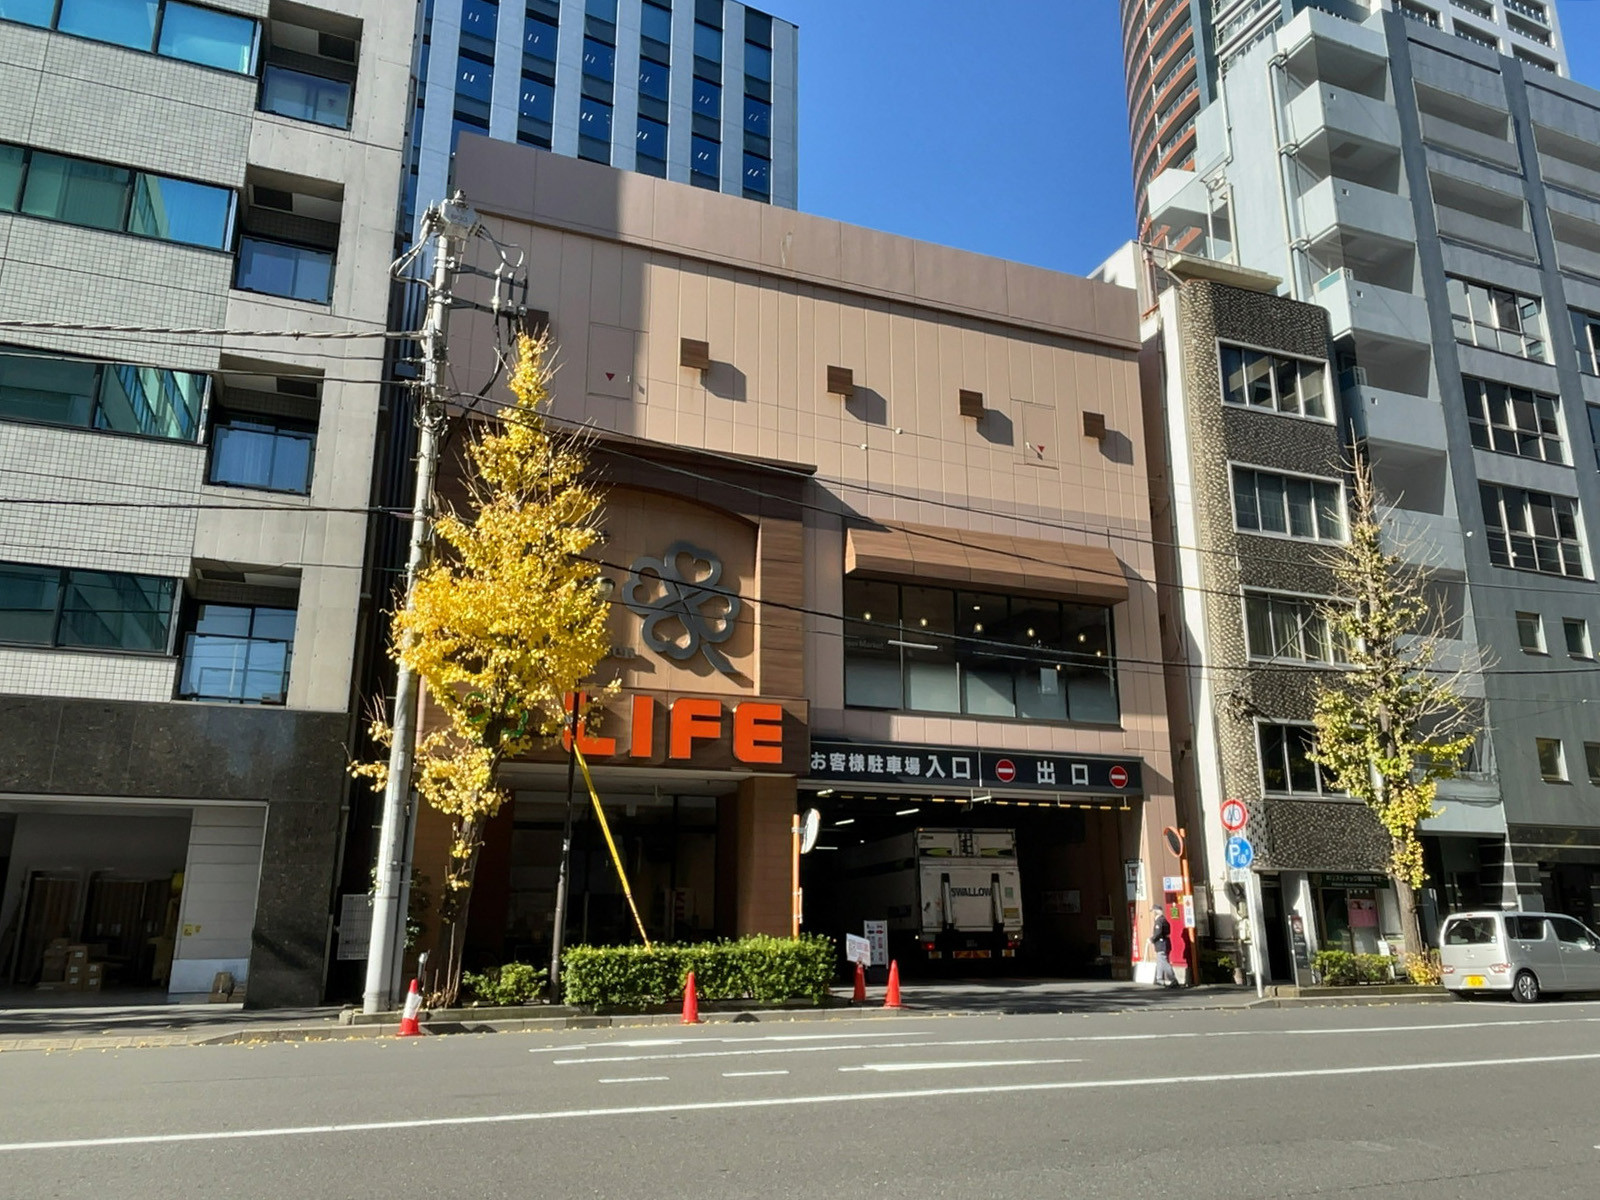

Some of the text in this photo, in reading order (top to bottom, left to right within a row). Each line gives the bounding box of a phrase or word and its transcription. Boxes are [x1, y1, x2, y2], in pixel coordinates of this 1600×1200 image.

[562, 691, 783, 764] LIFE
[810, 752, 971, 780] お客様駐車場入口
[1037, 760, 1089, 786] 出口
[951, 887, 993, 897] SWALLOW
